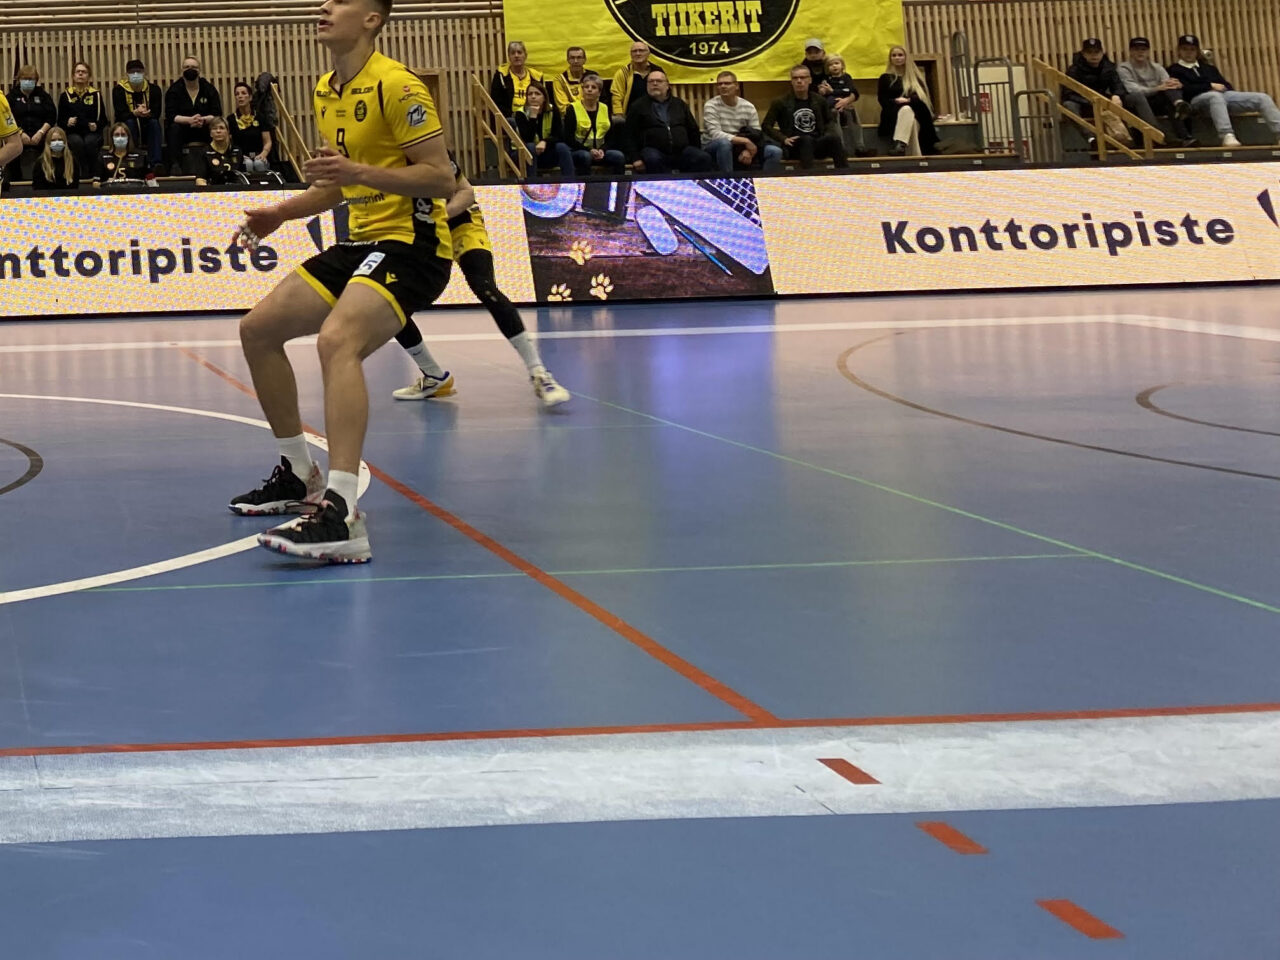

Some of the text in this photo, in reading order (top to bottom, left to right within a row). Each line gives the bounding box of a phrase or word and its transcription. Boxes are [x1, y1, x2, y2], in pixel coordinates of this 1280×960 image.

[651, 0, 762, 37] TIIKERIT
[689, 40, 731, 55] 1974
[336, 128, 350, 159] 9
[880, 210, 1236, 258] Konttoripiste
